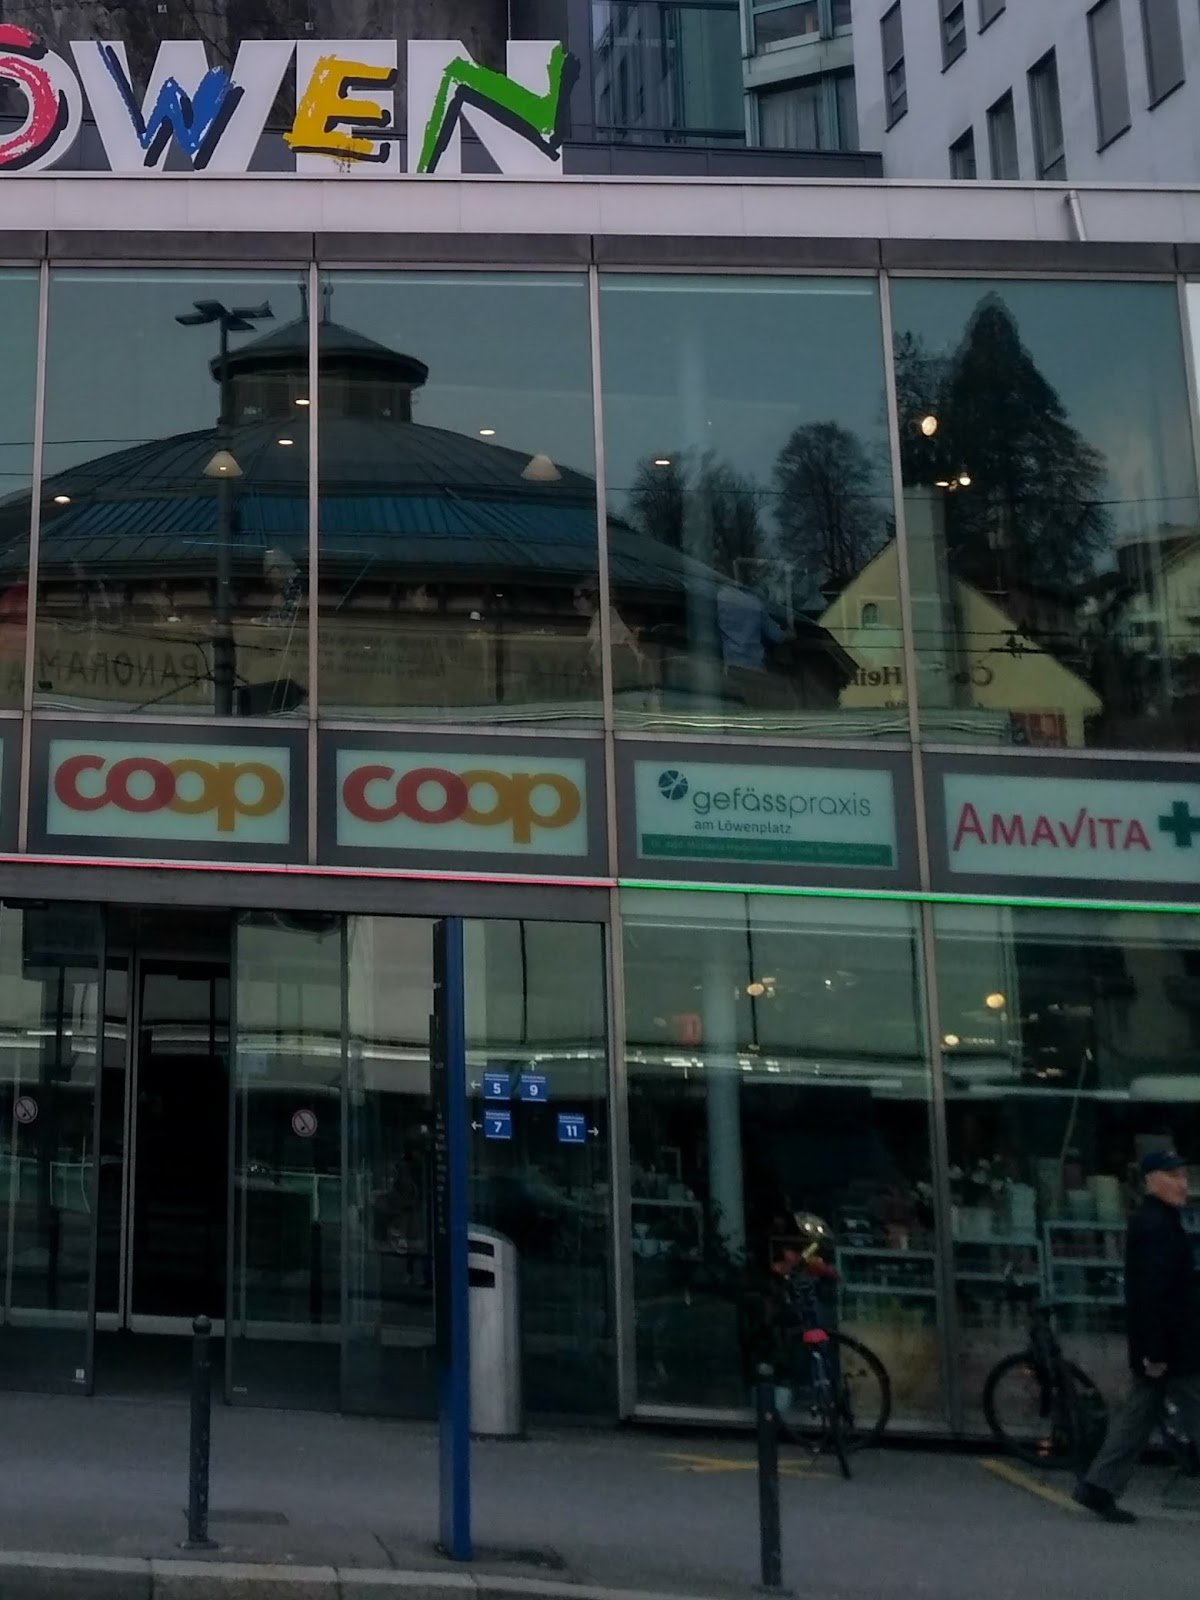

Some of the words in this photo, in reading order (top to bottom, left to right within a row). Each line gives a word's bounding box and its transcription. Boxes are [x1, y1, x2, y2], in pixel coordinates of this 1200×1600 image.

[54, 755, 285, 832] coop
[342, 765, 581, 844] coop
[693, 787, 872, 818] gefässpraxis
[694, 820, 714, 832] am
[717, 820, 792, 835] Löwenplatz
[953, 802, 1152, 852] AMAVITA
[493, 1083, 502, 1094] 5
[529, 1084, 539, 1096] 9
[494, 1121, 502, 1133] 7
[566, 1125, 578, 1137] 11
